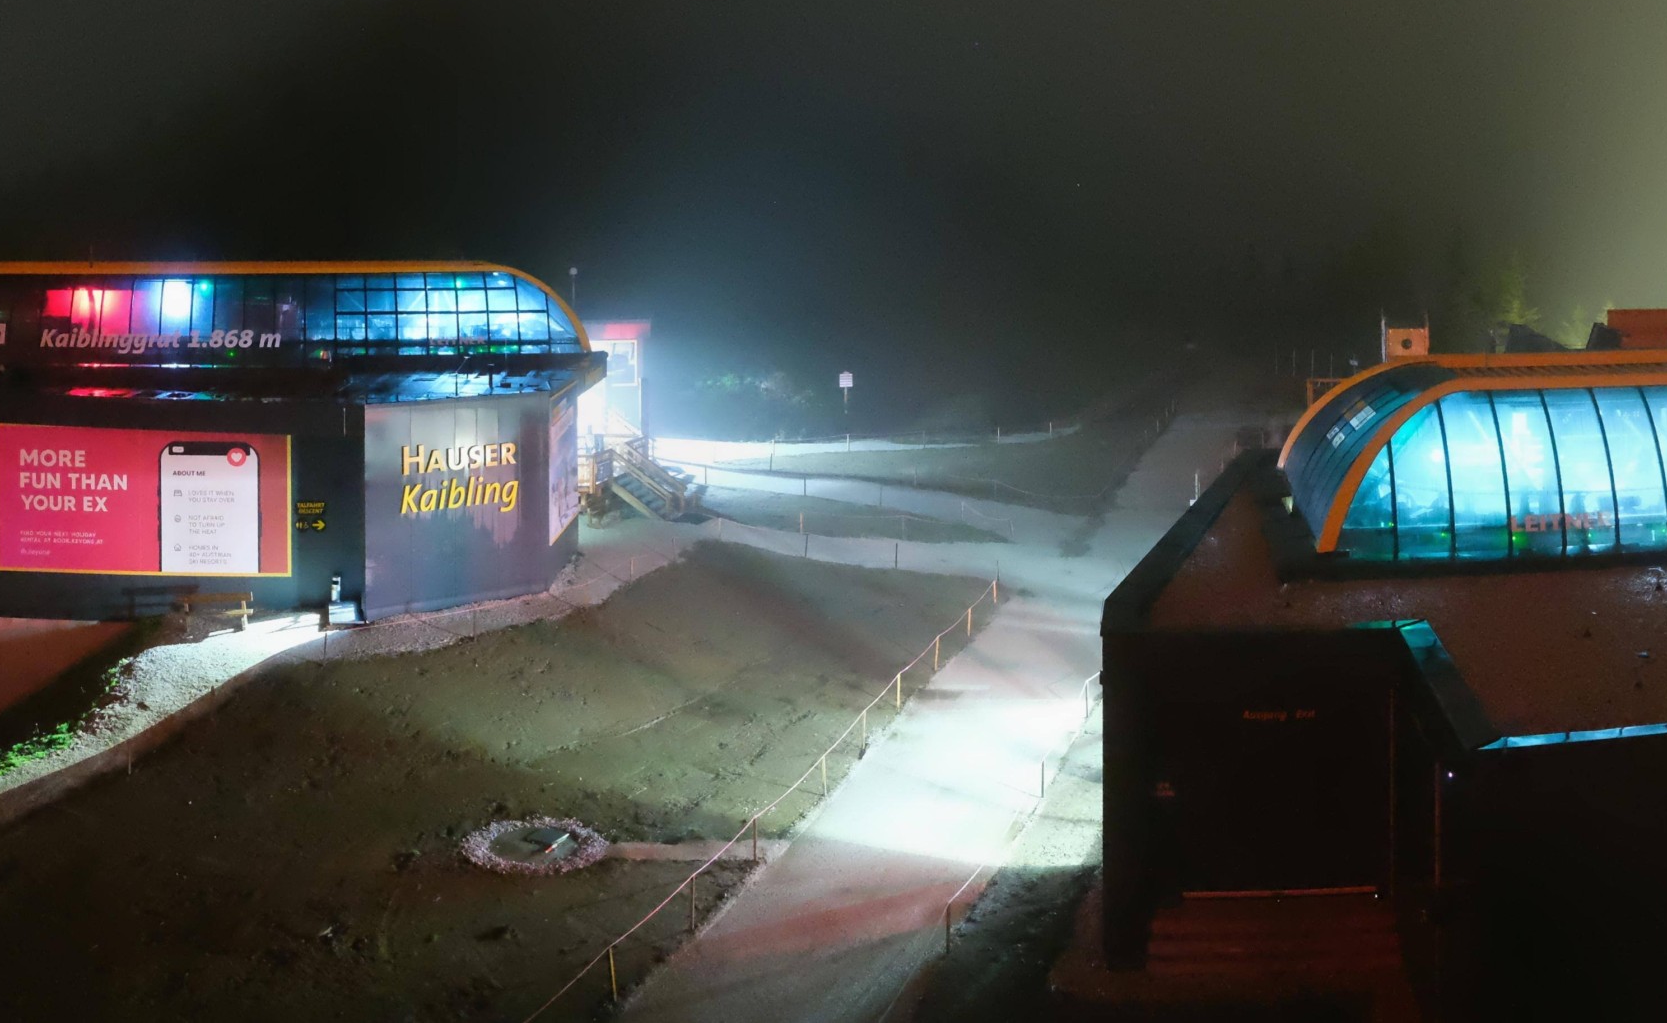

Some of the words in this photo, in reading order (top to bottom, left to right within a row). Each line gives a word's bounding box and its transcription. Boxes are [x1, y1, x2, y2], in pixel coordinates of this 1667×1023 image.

[40, 328, 180, 354] Kaiblinggrat
[187, 329, 254, 349] 1.868
[259, 332, 282, 349] m
[20, 449, 86, 467] MORE
[401, 442, 517, 476] HAUSER
[20, 472, 61, 489] FUN
[68, 473, 128, 490] THAN
[21, 495, 77, 511] YOUR
[83, 496, 108, 512] EX
[400, 477, 519, 514] Kaibling
